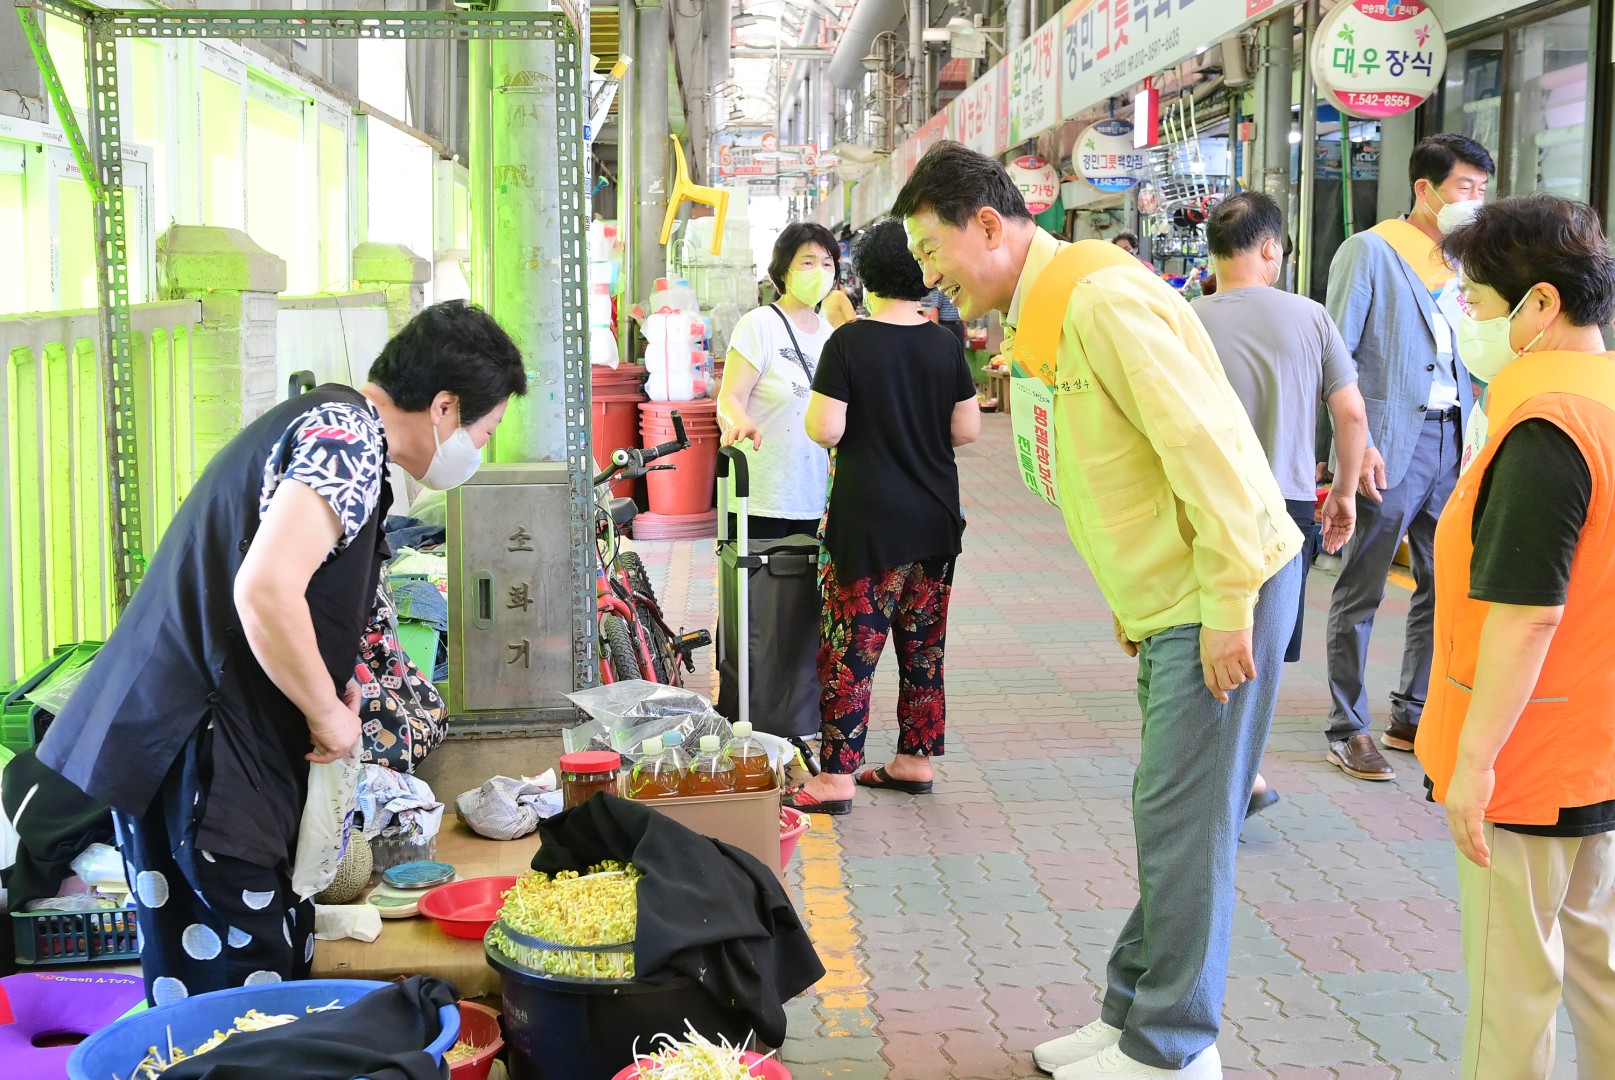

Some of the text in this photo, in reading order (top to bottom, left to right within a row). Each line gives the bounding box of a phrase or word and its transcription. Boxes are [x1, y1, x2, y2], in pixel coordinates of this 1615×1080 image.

[1348, 93, 1410, 107] T.542-8564
[1083, 154, 1143, 170] 경민그릇백화점
[1017, 184, 1055, 198] 구가방
[506, 524, 534, 669] 소화기
